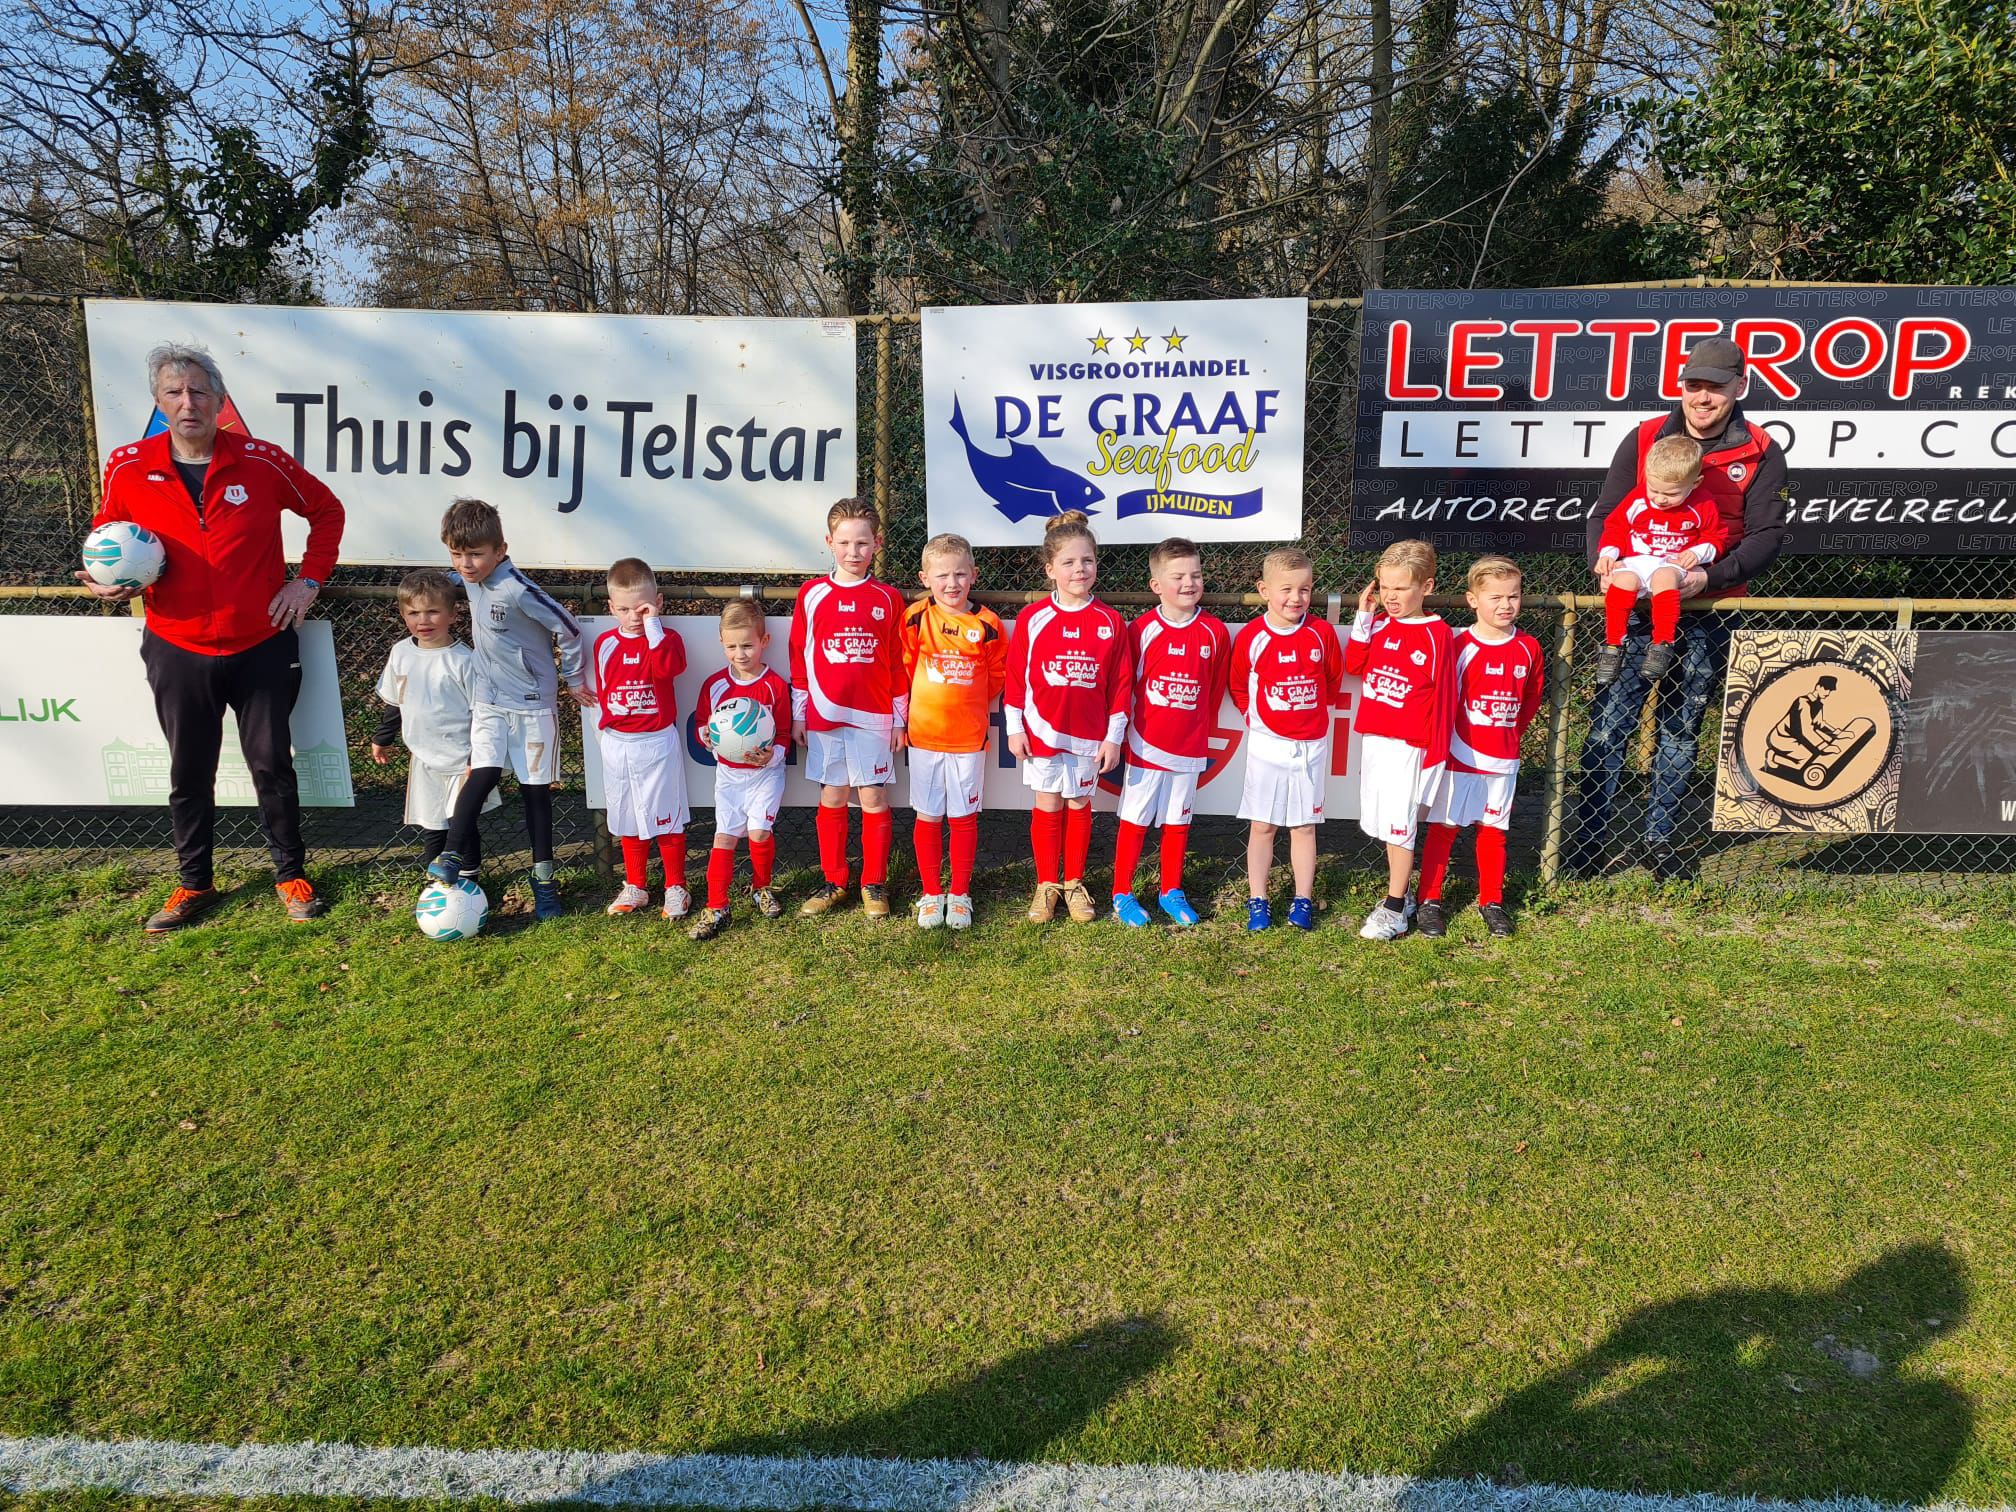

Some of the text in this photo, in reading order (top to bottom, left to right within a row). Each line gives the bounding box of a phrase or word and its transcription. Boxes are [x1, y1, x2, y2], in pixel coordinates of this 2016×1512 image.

[1366, 289, 2016, 310] LETTEROP LETTEROP LETTEROP LETTEROP LETTERO
[1029, 359, 1250, 381] VISGROOTHANDEL
[1385, 316, 1972, 402] LETTEROP
[994, 389, 1281, 439] DE GRAAF
[276, 385, 843, 514] Thuis bij Telstar
[1087, 427, 1260, 494] Seafood
[1826, 480, 1938, 497] LETTEROP
[1145, 493, 1233, 517] IJMUIDEN
[1819, 534, 1930, 550] LETTEROP
[625, 690, 654, 701] GRAA
[527, 742, 545, 773] 7
